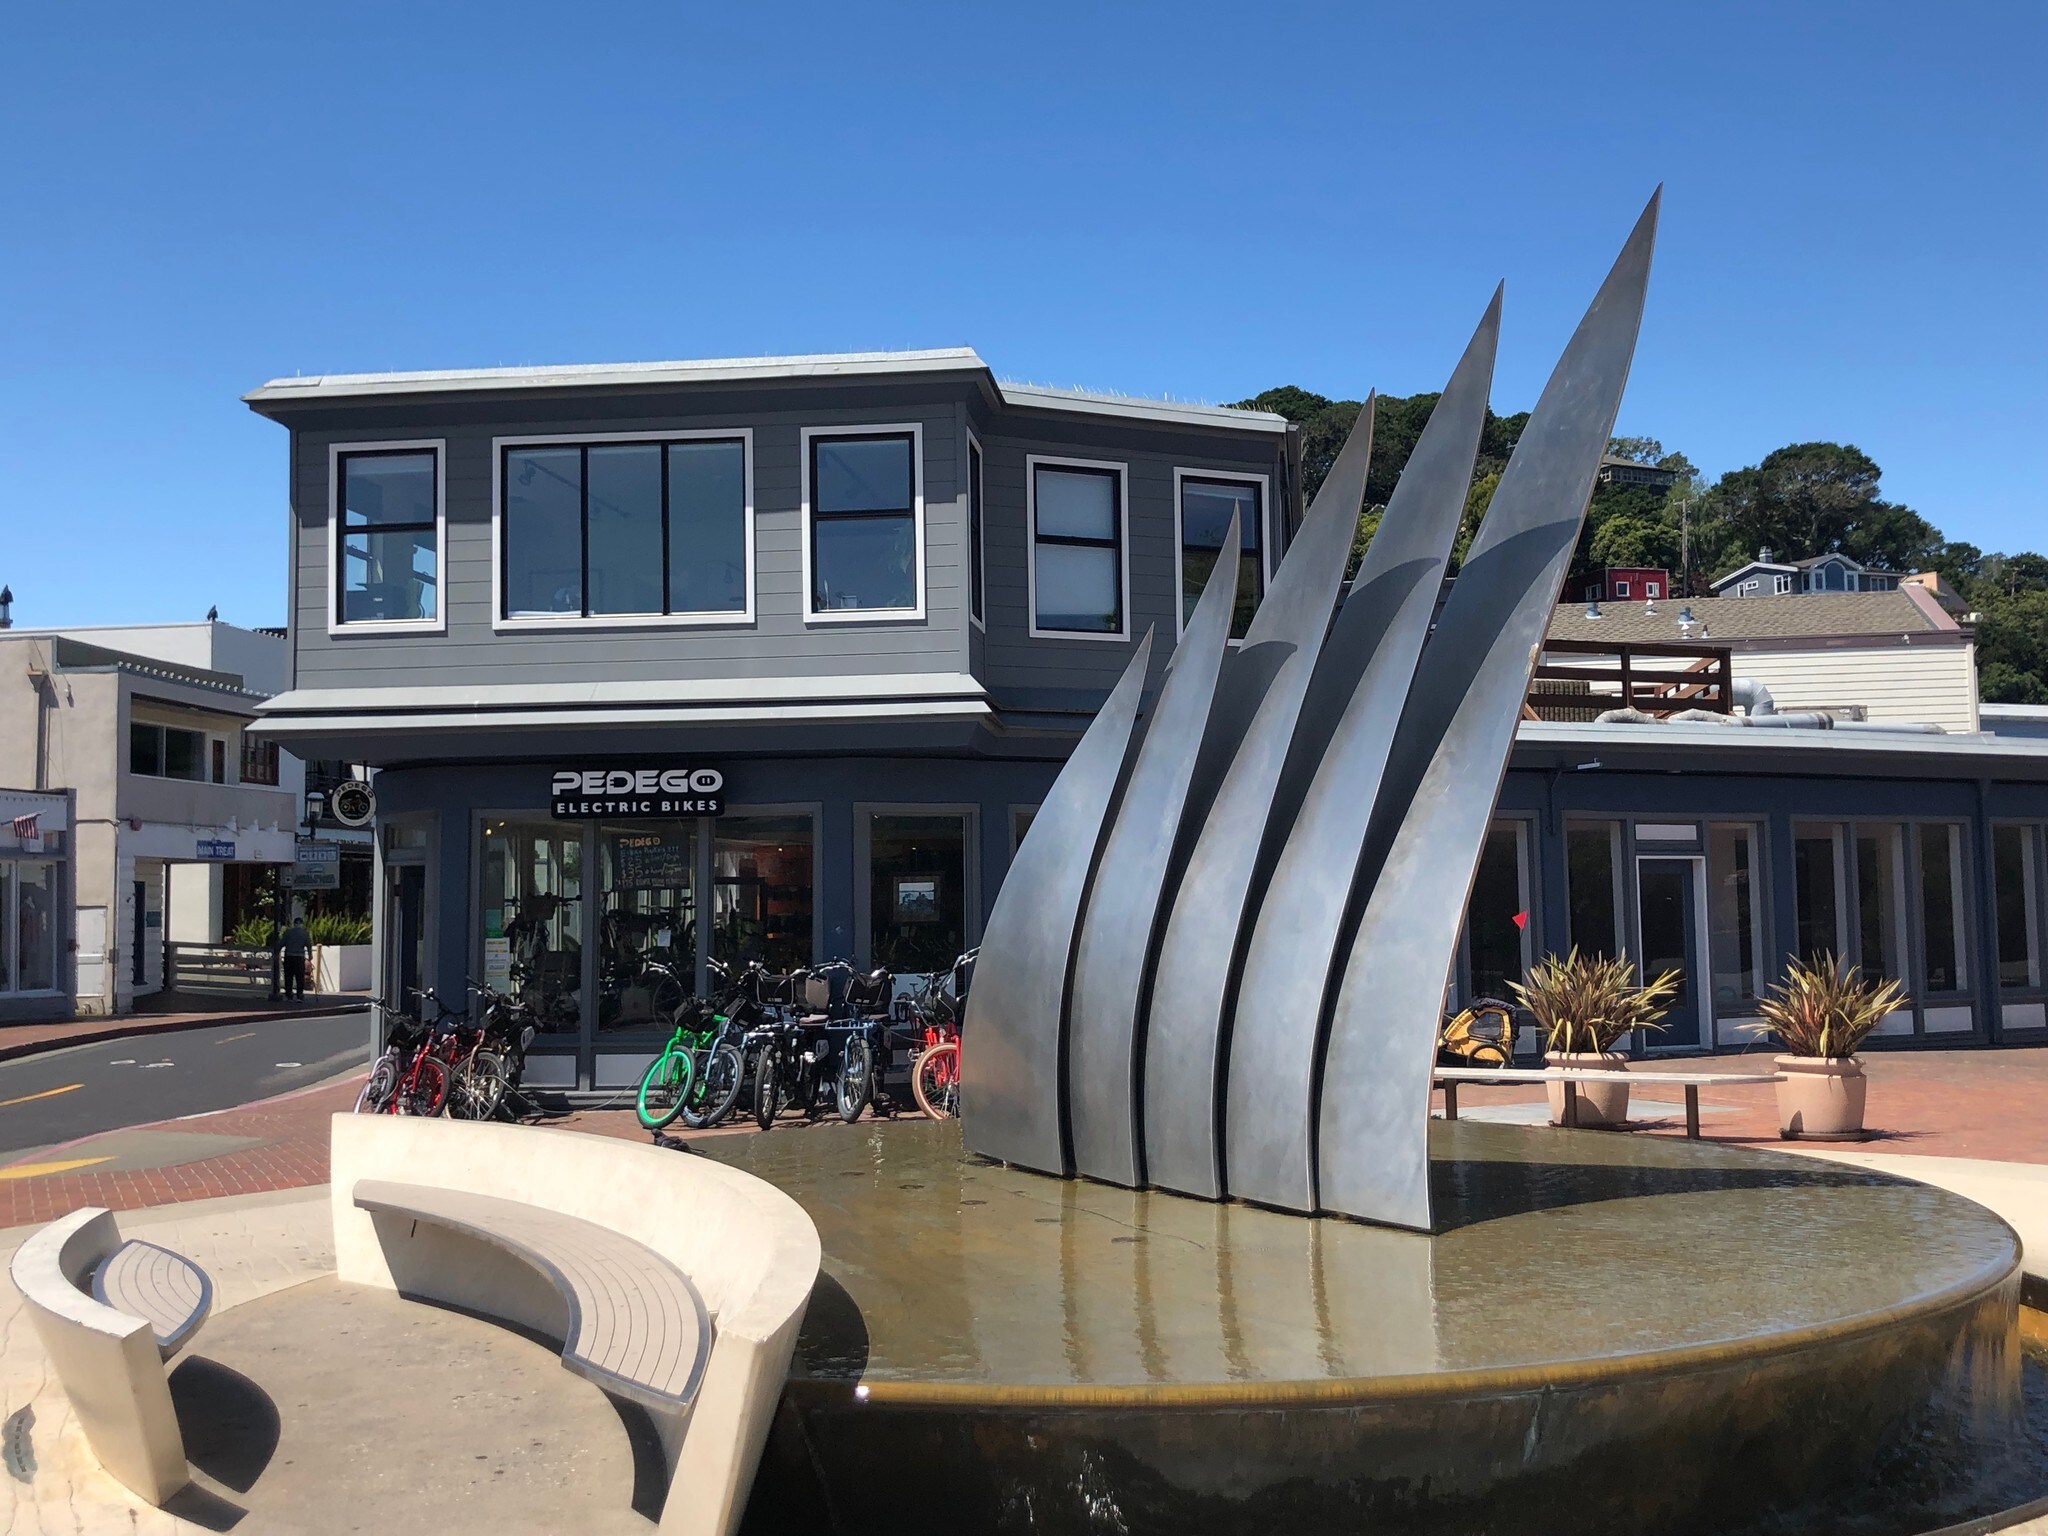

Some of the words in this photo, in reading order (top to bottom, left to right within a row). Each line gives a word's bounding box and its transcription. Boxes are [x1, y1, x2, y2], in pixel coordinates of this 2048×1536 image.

[552, 769, 723, 795] PEDEGO
[336, 782, 374, 798] PEDEGO
[557, 802, 650, 813] ELECTRIC
[661, 800, 718, 812] BIKES
[619, 837, 661, 848] PEDEGO
[197, 845, 214, 856] MAIN
